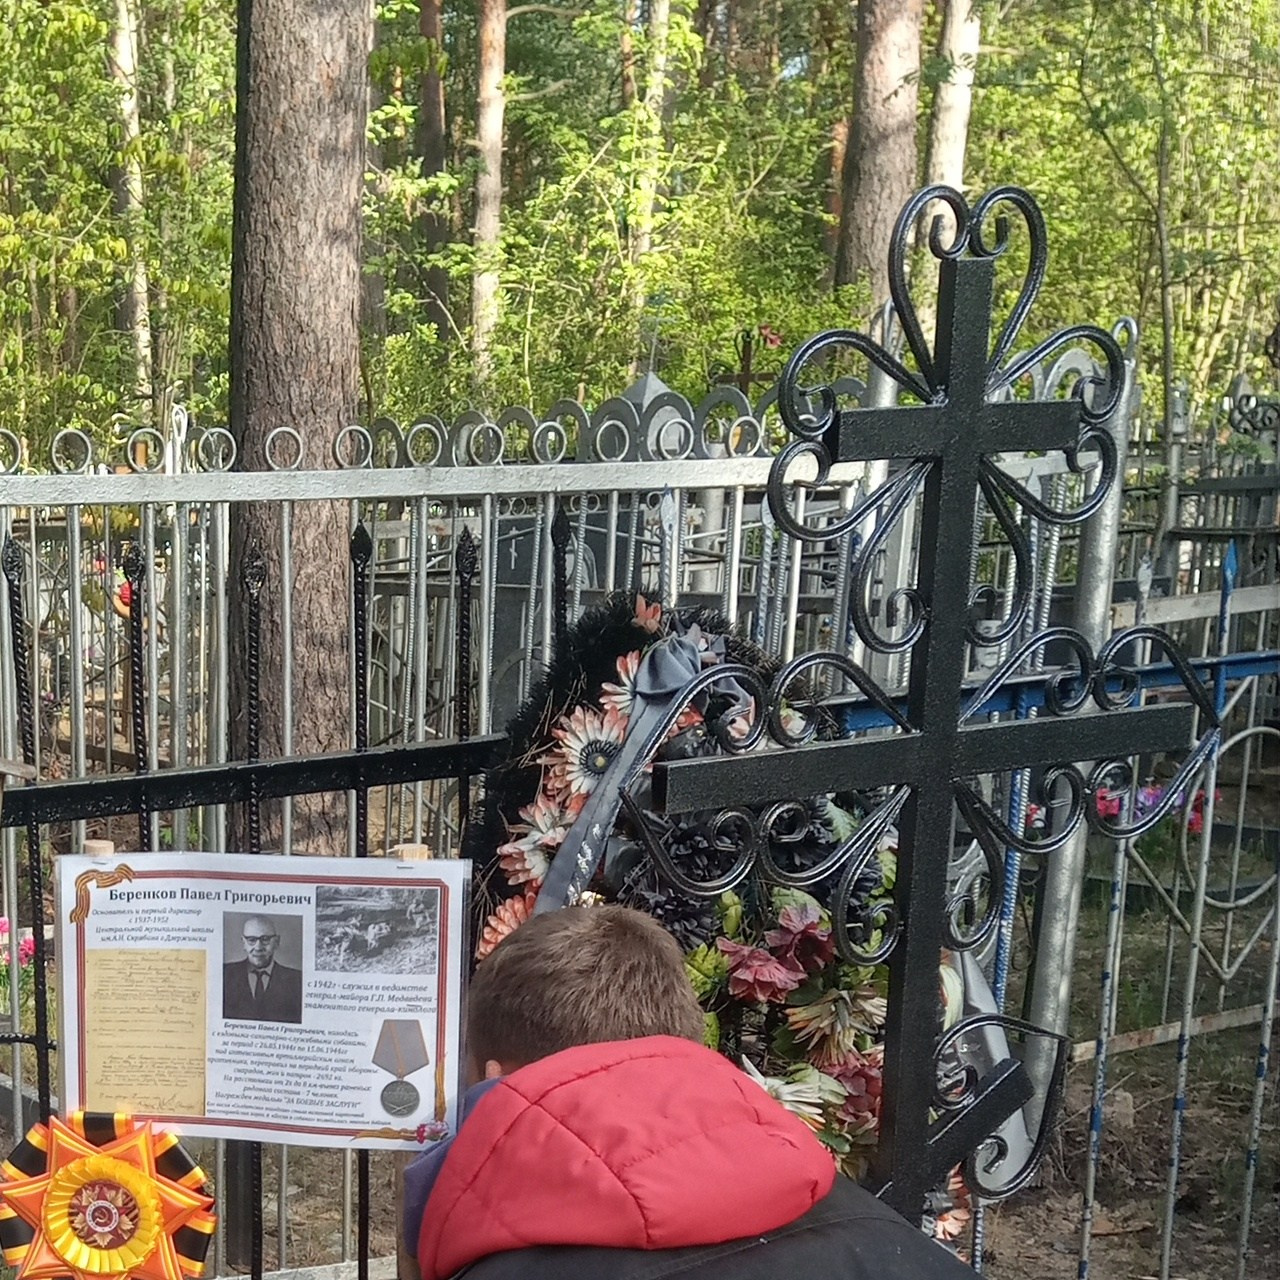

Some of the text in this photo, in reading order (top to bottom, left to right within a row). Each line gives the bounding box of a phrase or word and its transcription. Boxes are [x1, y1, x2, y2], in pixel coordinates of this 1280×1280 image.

[110, 888, 312, 906] Беренков Павел Григорьевич
[342, 982, 373, 991] служил
[224, 1021, 257, 1030] Беренков
[258, 1023, 279, 1032] Павел
